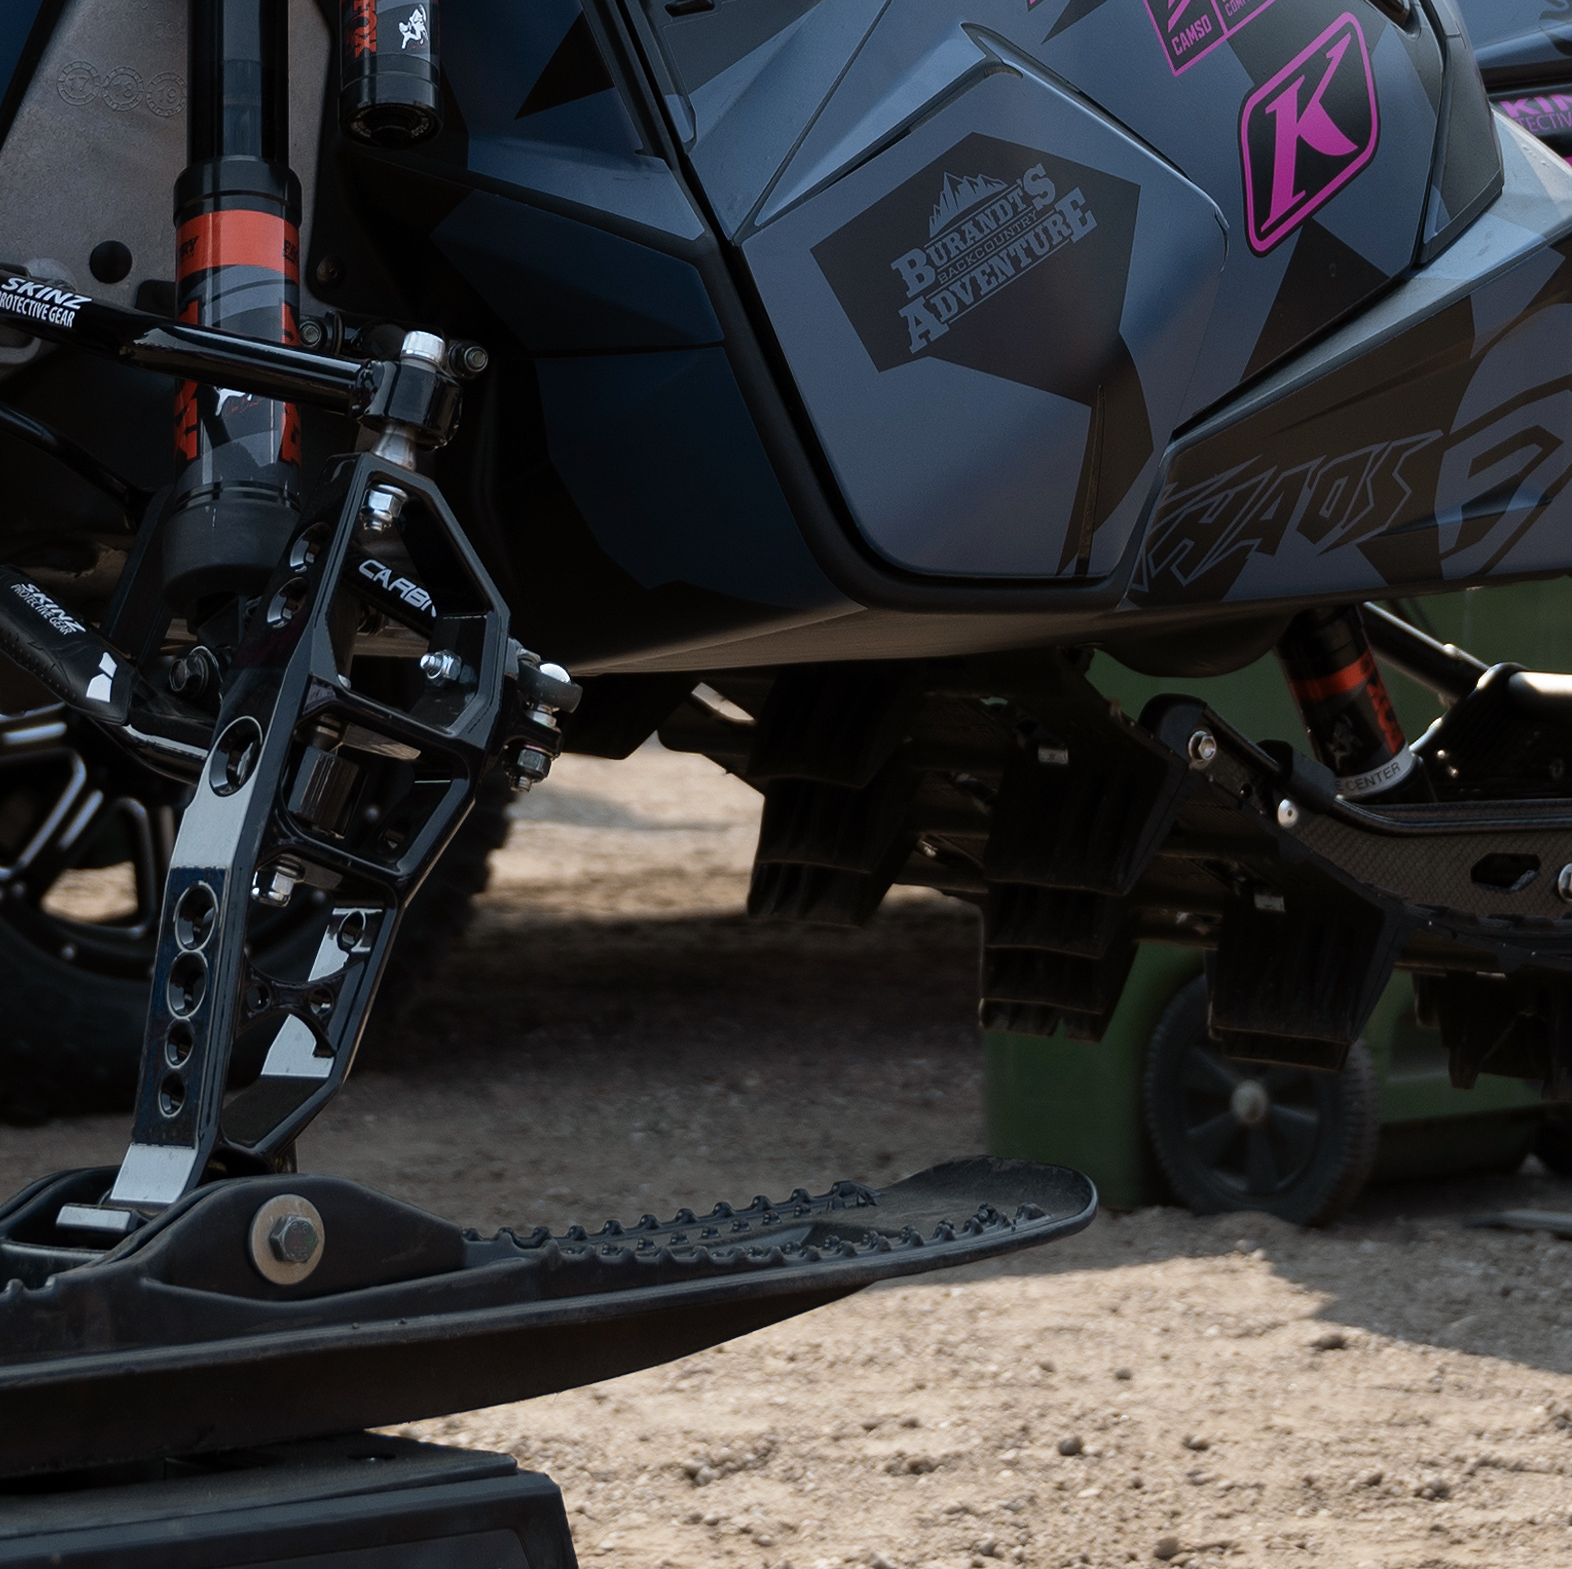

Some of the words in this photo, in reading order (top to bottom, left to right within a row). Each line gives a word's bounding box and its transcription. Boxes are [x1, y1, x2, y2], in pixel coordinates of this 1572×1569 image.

[1171, 14, 1214, 56] CAMSO
[890, 162, 1057, 299] BURANDT'S
[937, 207, 1039, 284] BACKCOUNTRY
[0, 276, 93, 311] SKINZ
[898, 186, 1098, 354] ADVENTURE
[48, 306, 76, 329] GEAR
[21, 582, 87, 633] SKINZ
